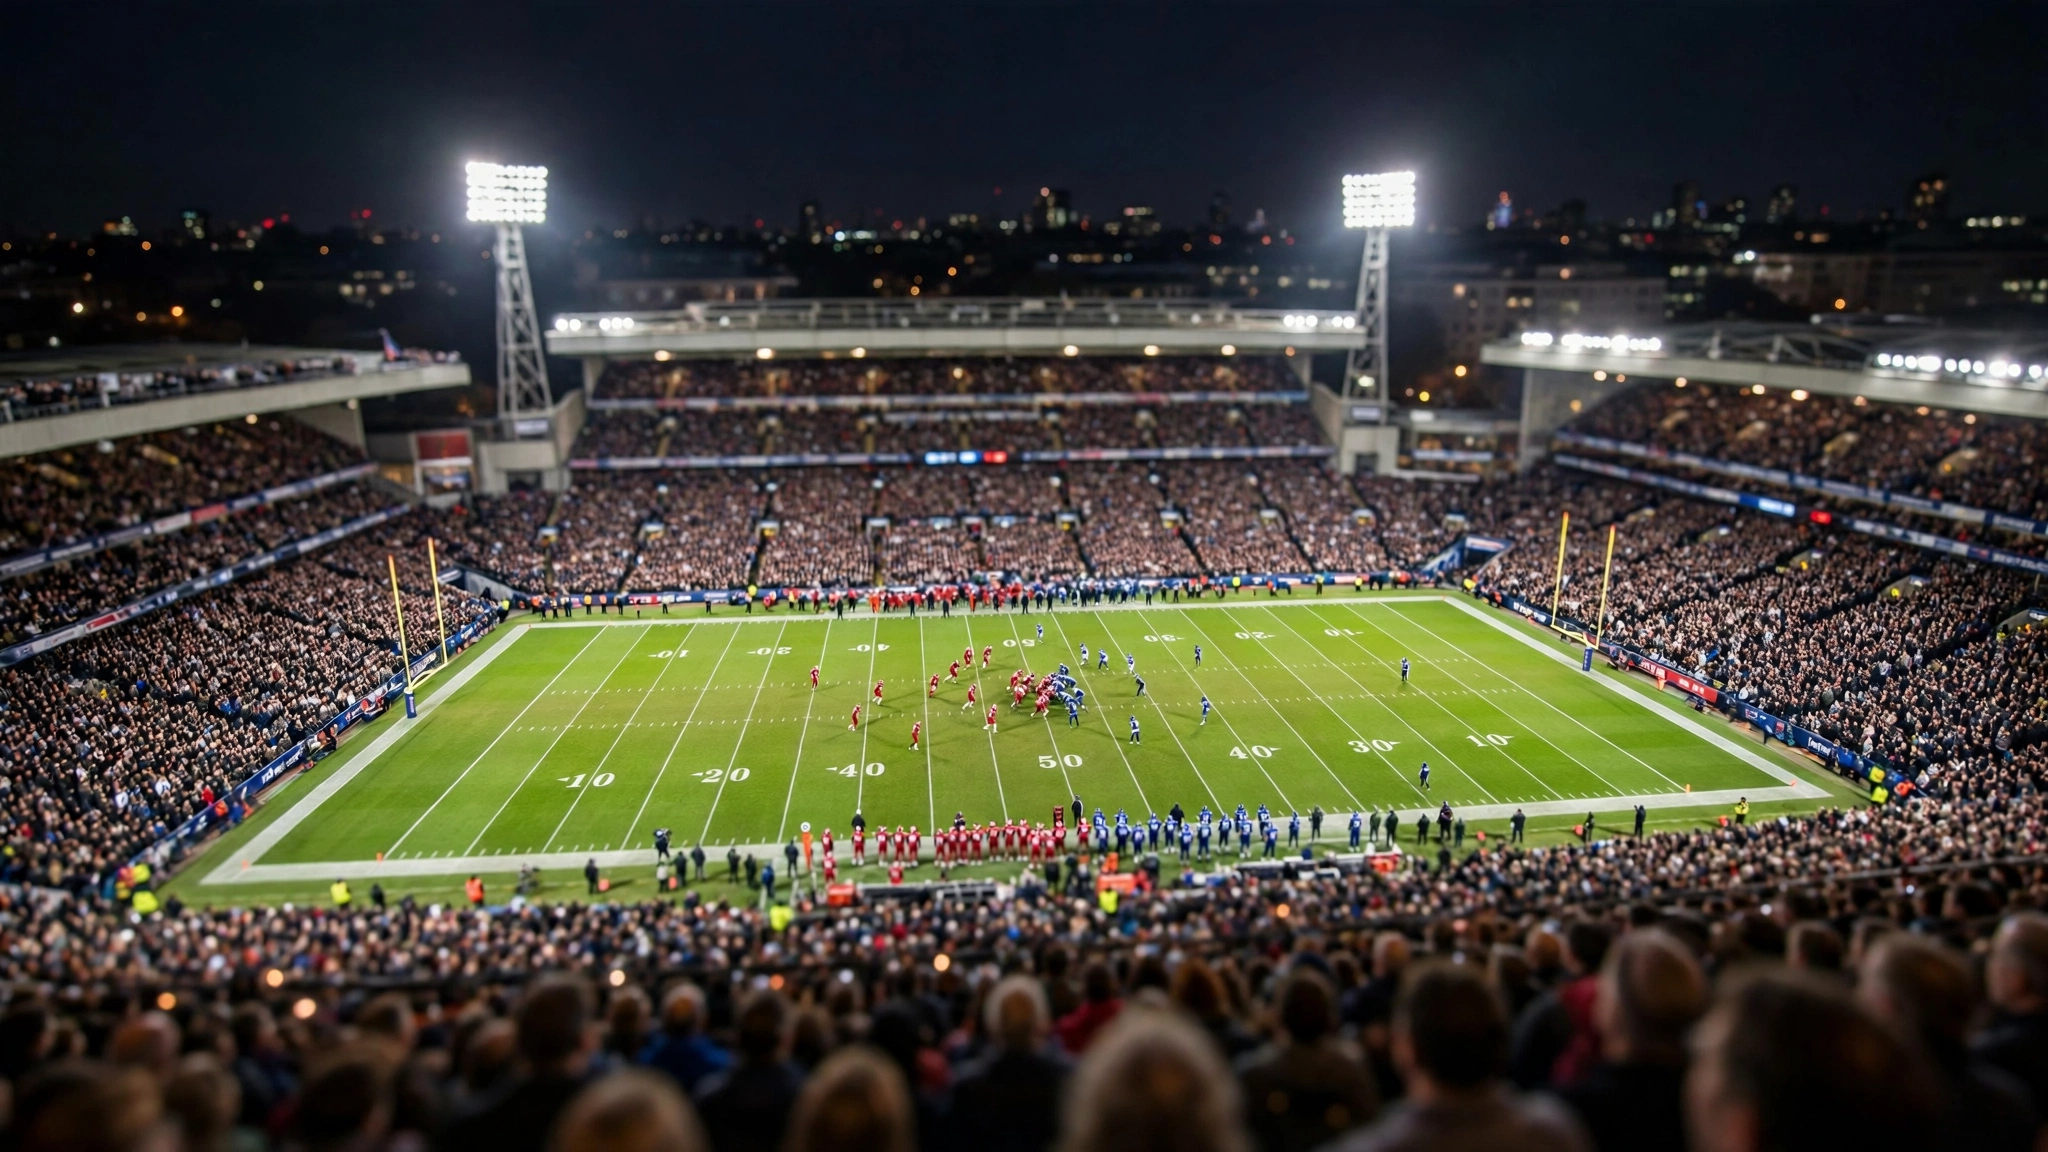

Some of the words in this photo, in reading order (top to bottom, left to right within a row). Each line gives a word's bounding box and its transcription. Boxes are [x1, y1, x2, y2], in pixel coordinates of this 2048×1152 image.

[1347, 739, 1393, 754] 30
[1466, 733, 1509, 747] 10
[1229, 745, 1273, 760] 40
[1039, 754, 1083, 769] 50
[700, 768, 751, 783] 20
[839, 762, 885, 777] 40
[565, 773, 615, 788] 10
